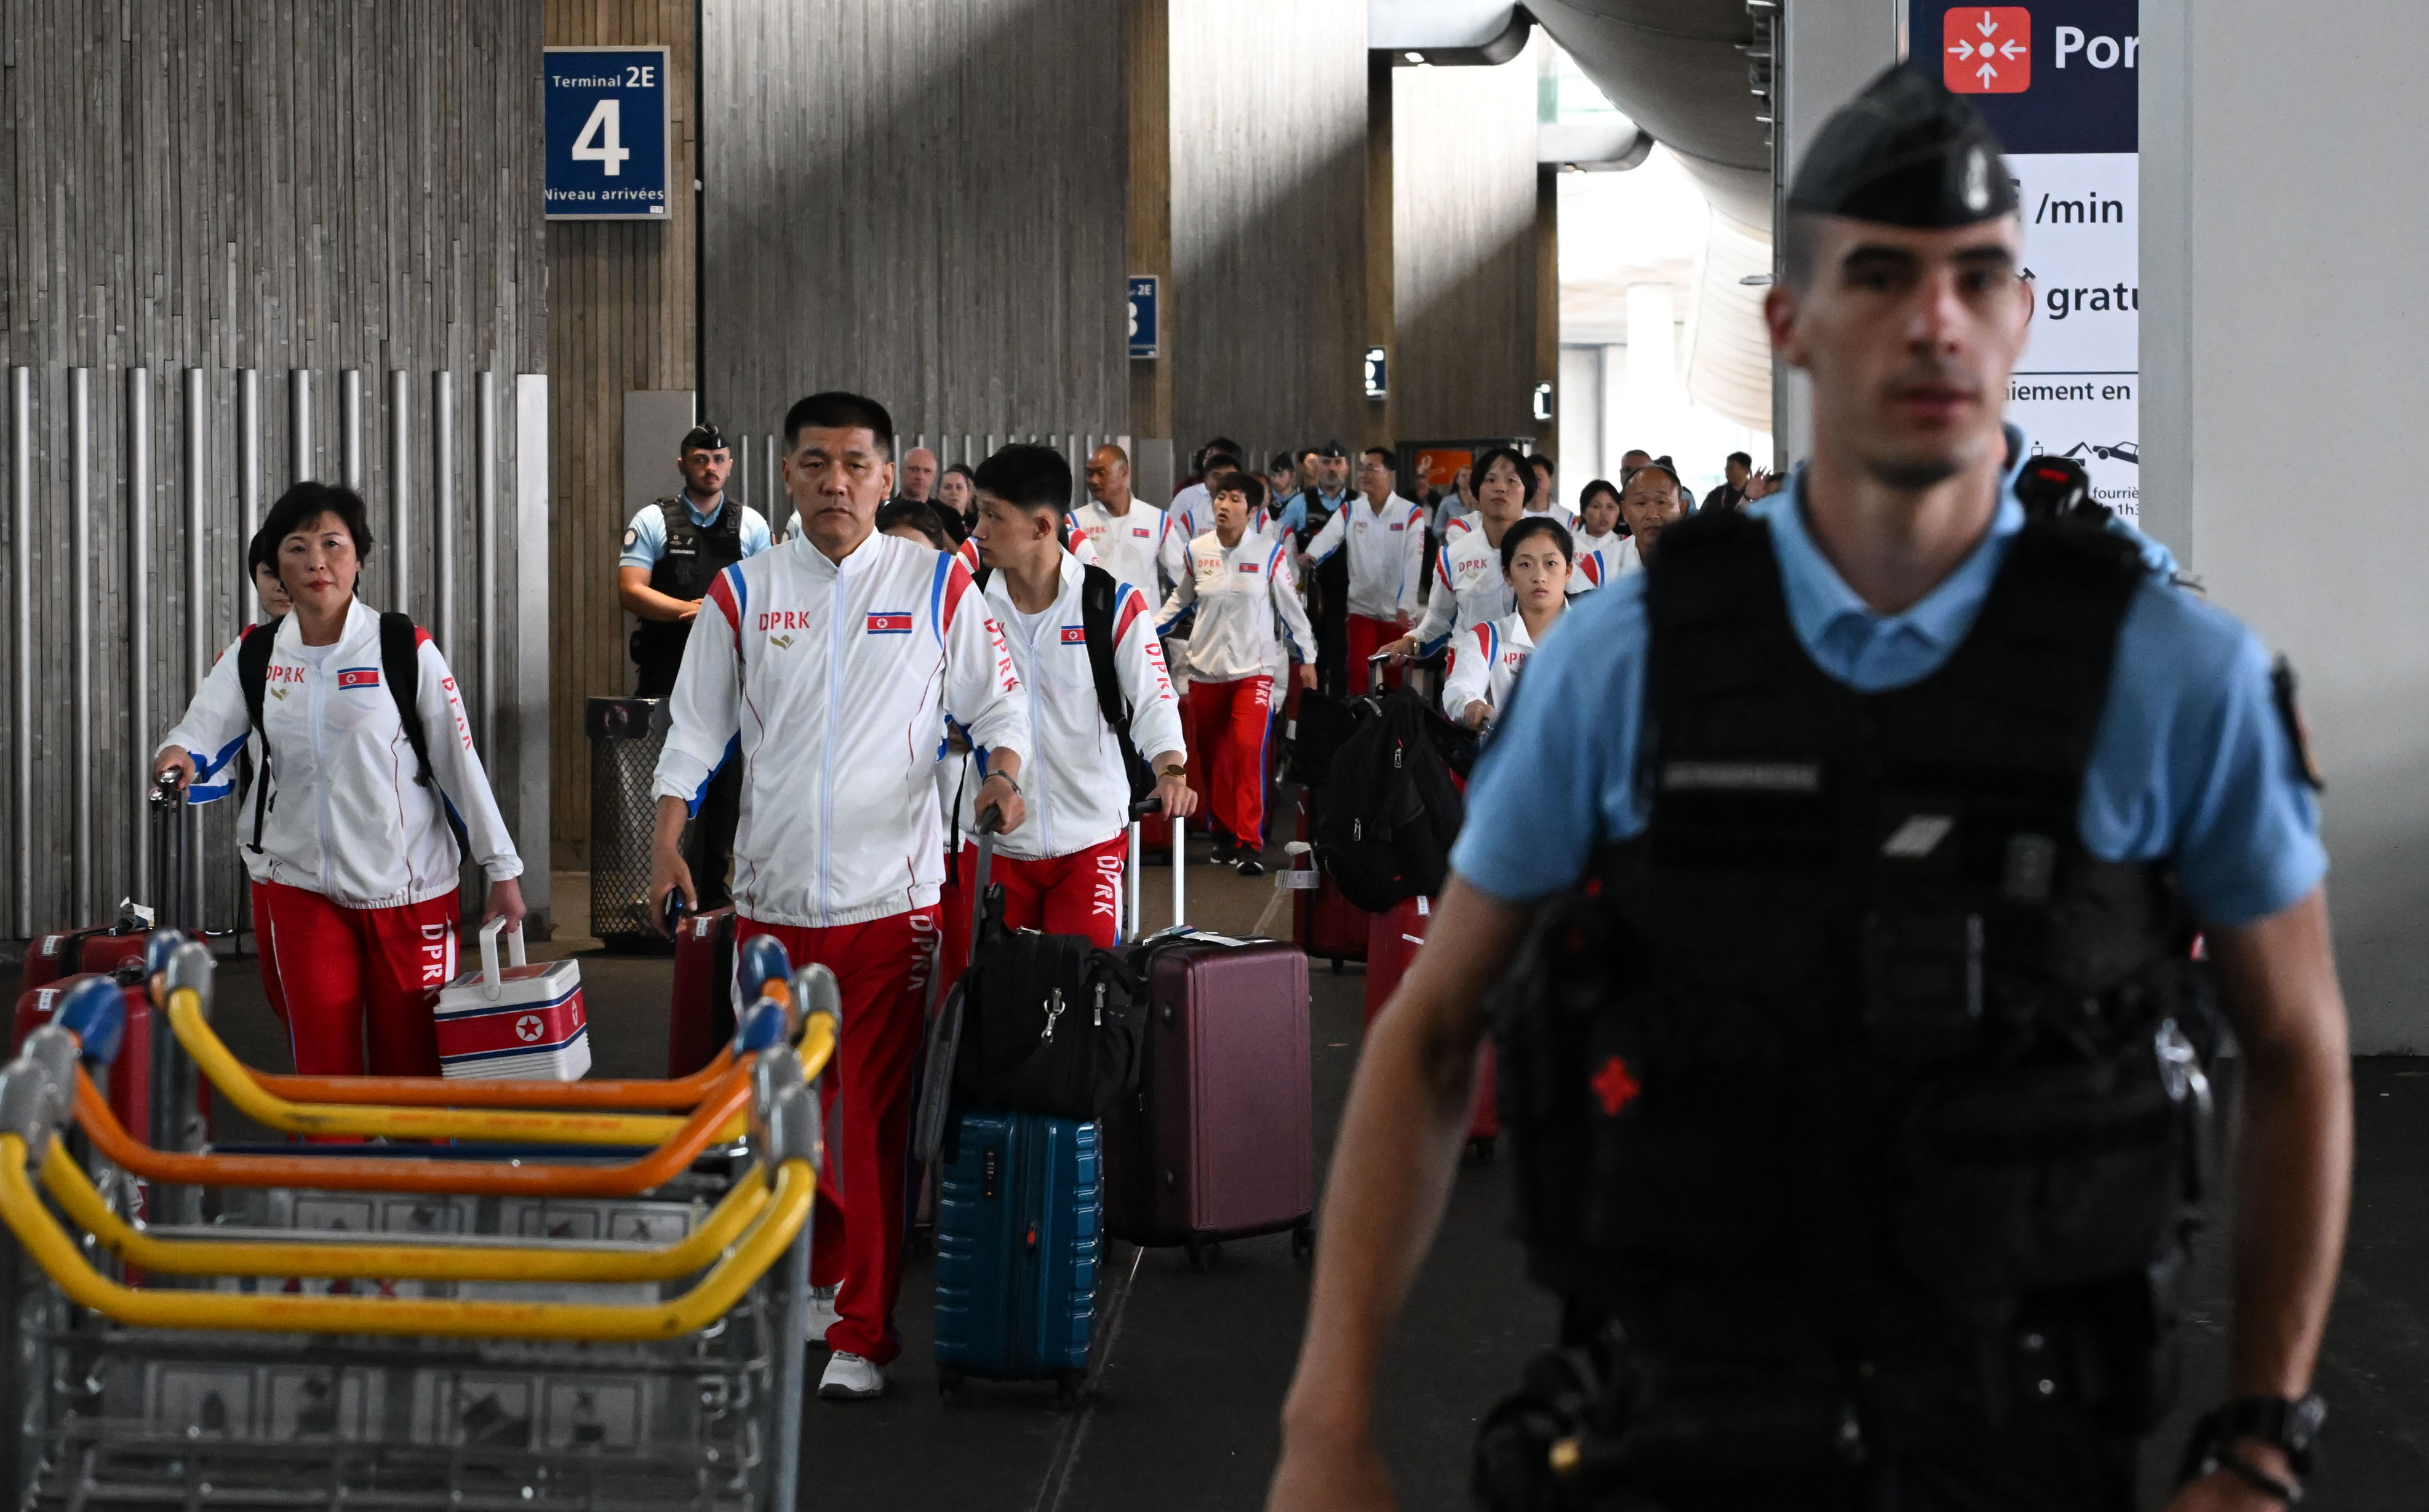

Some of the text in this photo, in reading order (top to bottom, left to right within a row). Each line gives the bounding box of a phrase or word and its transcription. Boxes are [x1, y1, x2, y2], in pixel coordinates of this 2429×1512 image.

[2055, 26, 2139, 69] Por
[552, 66, 655, 87] Terminal 2E
[572, 99, 629, 176] 4
[544, 187, 664, 200] Niveau arrivées
[2035, 191, 2123, 224] /min
[1138, 284, 1152, 295] 2E
[2007, 381, 2131, 400] iement en
[1198, 559, 1221, 568] DPRK
[1459, 559, 1487, 572] DPRK
[759, 611, 811, 632] DPRK
[984, 618, 1020, 692] DPRK
[1091, 855, 1120, 918] DPRK
[907, 915, 936, 992] DPRK
